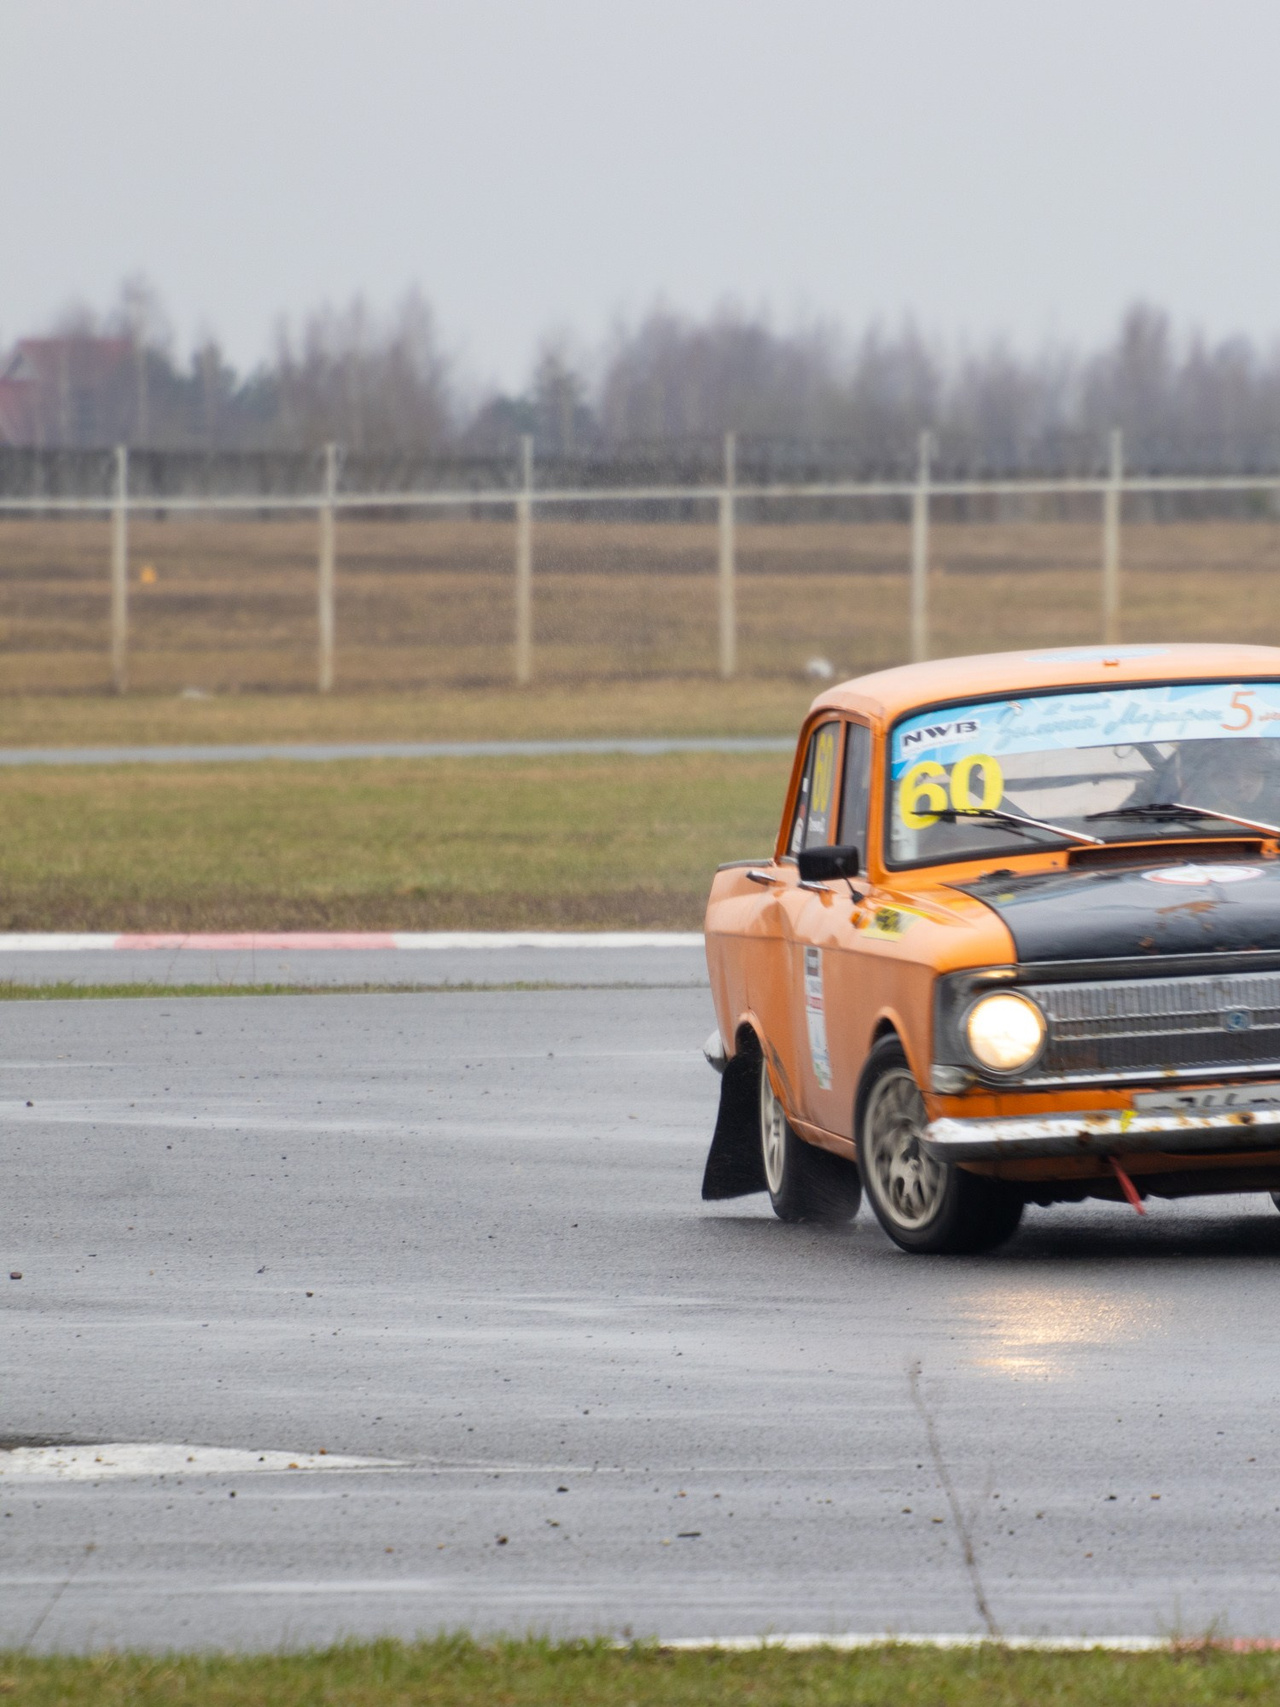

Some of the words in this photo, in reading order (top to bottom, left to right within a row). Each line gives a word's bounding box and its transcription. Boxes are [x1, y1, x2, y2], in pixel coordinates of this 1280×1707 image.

[902, 721, 977, 746] NWB
[1221, 691, 1257, 731] 5
[812, 733, 834, 812] 60
[898, 752, 1004, 830] 60
